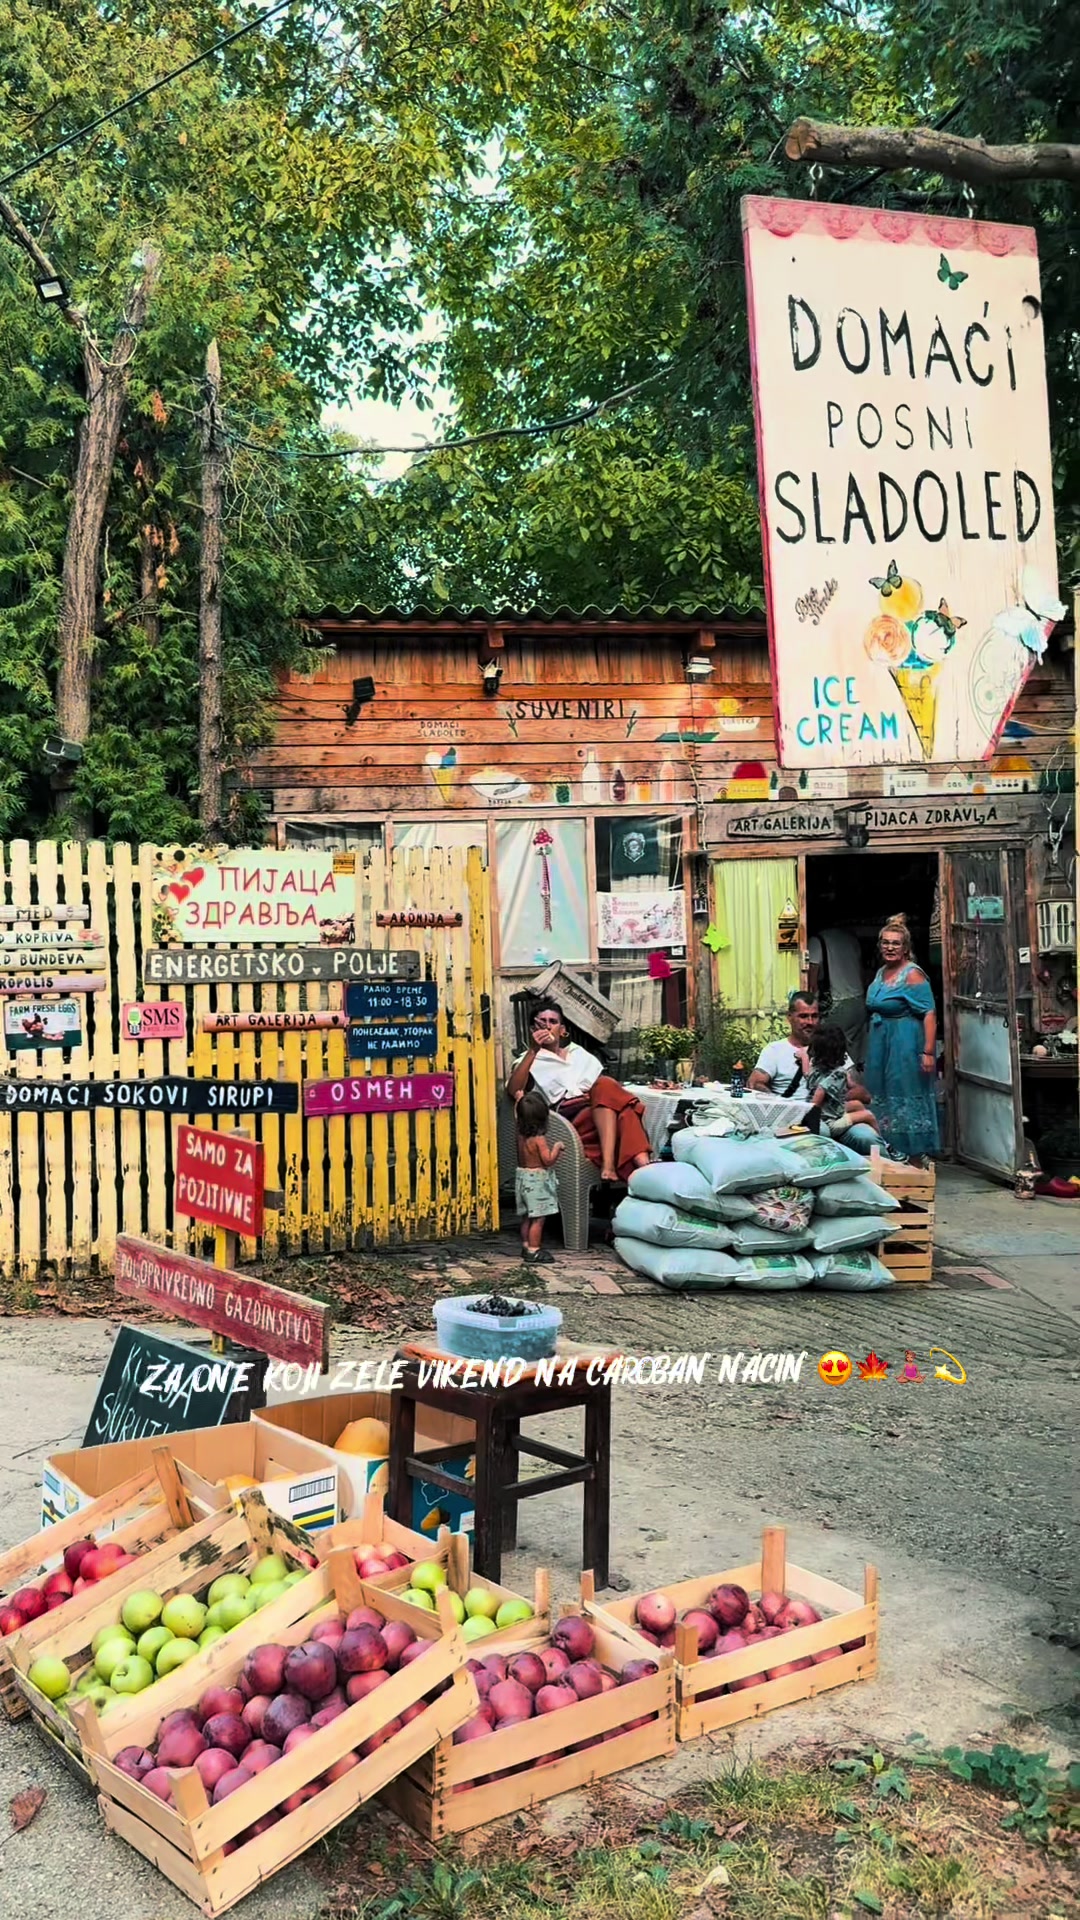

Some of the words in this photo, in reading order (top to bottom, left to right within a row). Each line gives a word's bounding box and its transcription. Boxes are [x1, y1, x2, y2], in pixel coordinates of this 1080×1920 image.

[827, 401, 973, 449] POSNI
[774, 468, 1041, 545] SLADOLED
[813, 676, 860, 709] ICE
[515, 699, 624, 719] SUVENIRI
[796, 711, 899, 747] CREAM
[734, 818, 758, 832] ART
[762, 815, 832, 832] GALERIJA
[865, 809, 919, 828] PIJACA
[217, 866, 336, 896] ПИЈАЦА
[16, 907, 53, 919] MED
[185, 900, 318, 929] ЗДРАВЉА
[16, 933, 74, 945] KOPRIVA
[20, 953, 85, 966] BUNDEVA
[150, 952, 304, 979] ENERGETSKO
[333, 951, 399, 976] POLJE
[0, 977, 54, 989] ROPOLIS
[9, 1006, 30, 1016] FARM
[32, 1004, 56, 1014] FRESH
[58, 1003, 76, 1014] EGGS
[142, 1007, 180, 1026] SMS
[216, 1015, 238, 1027] ART
[248, 1013, 317, 1027] GALERIJA
[103, 1083, 187, 1105] SOKOVI
[207, 1085, 273, 1107] SIRUPI
[331, 1080, 413, 1102] OSMEH
[186, 1132, 226, 1165] SAMO
[234, 1147, 253, 1180] ZA
[179, 1178, 253, 1225] POZITIVNE
[225, 1291, 311, 1345] GAZDINSTVO
[95, 1392, 178, 1442] SURUT
